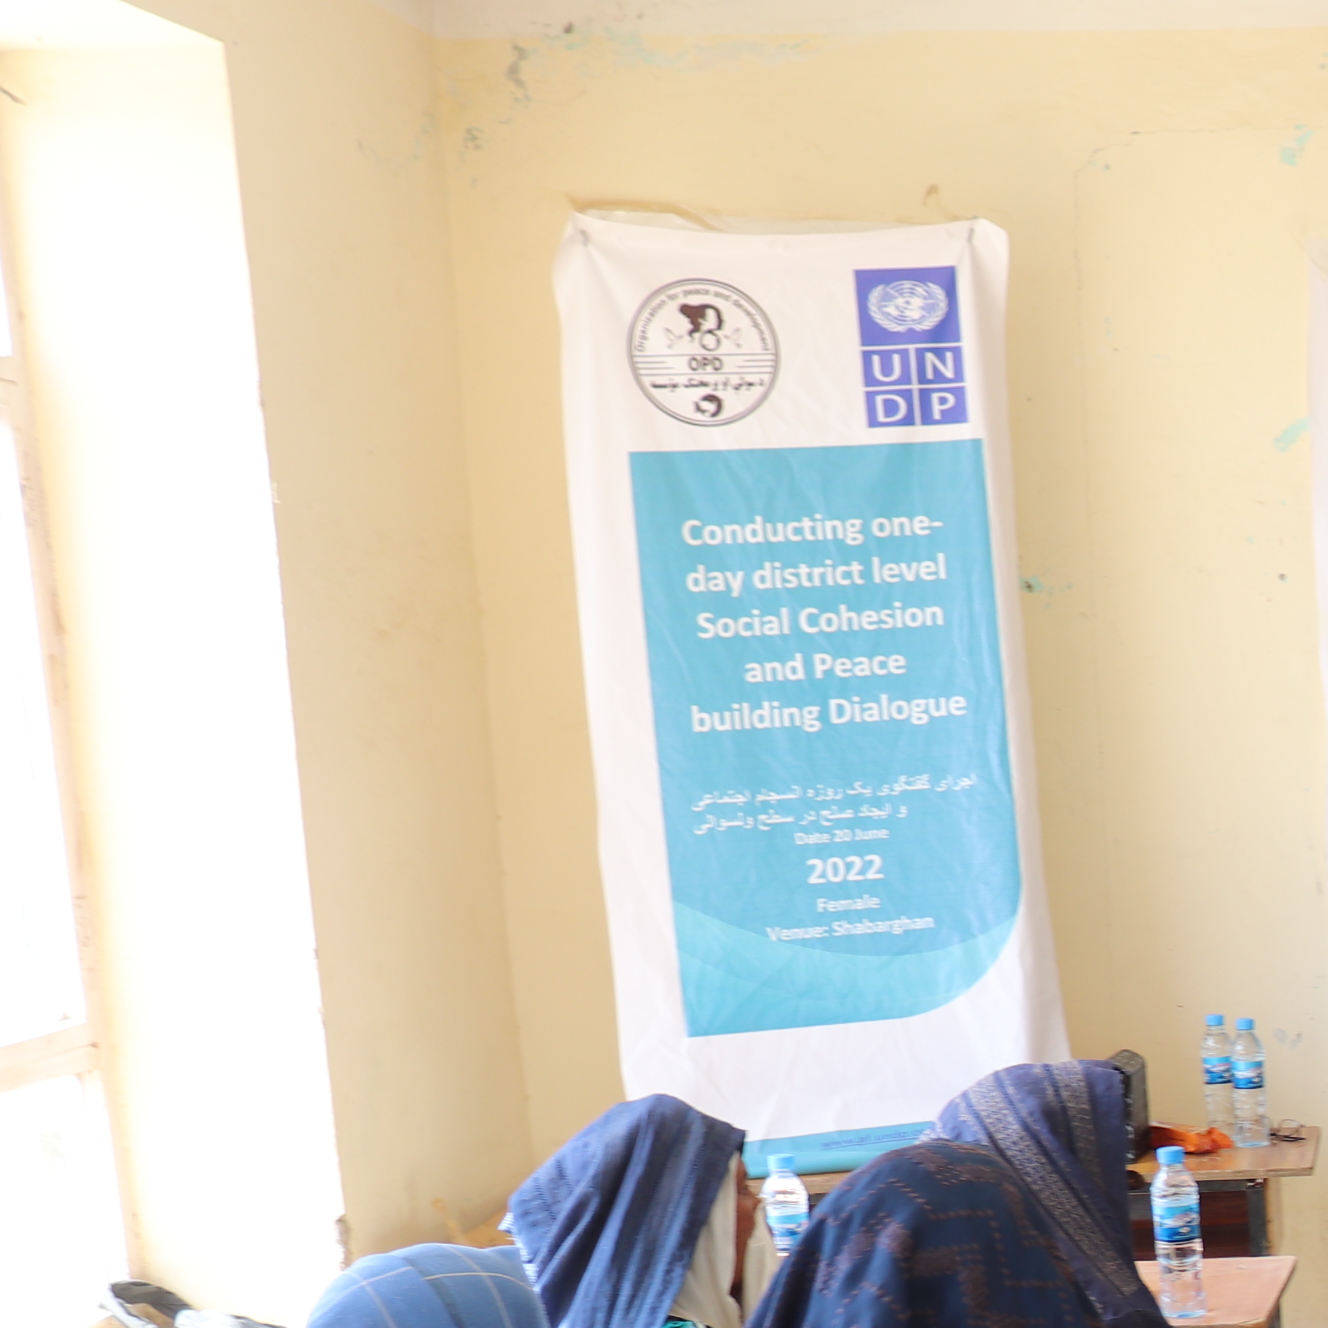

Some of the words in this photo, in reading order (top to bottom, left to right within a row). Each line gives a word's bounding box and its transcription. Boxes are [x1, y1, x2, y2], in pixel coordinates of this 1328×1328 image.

[688, 357, 723, 371] OPD
[681, 513, 865, 546] Conducting
[871, 515, 944, 538] one-
[686, 564, 745, 598] day
[751, 559, 866, 590] district
[871, 552, 948, 584] level
[696, 607, 791, 640] Social
[798, 601, 945, 634] Cohesion
[744, 652, 806, 684] and
[812, 652, 907, 679] Peace
[690, 701, 822, 733] building
[828, 693, 968, 726] Dialogue
[794, 832, 829, 846] Date
[832, 829, 853, 843] 20
[853, 828, 890, 841] June
[806, 854, 885, 885] 2022
[816, 894, 881, 913] Female
[765, 926, 829, 942] Venue:
[831, 915, 935, 937] Shabarghan
